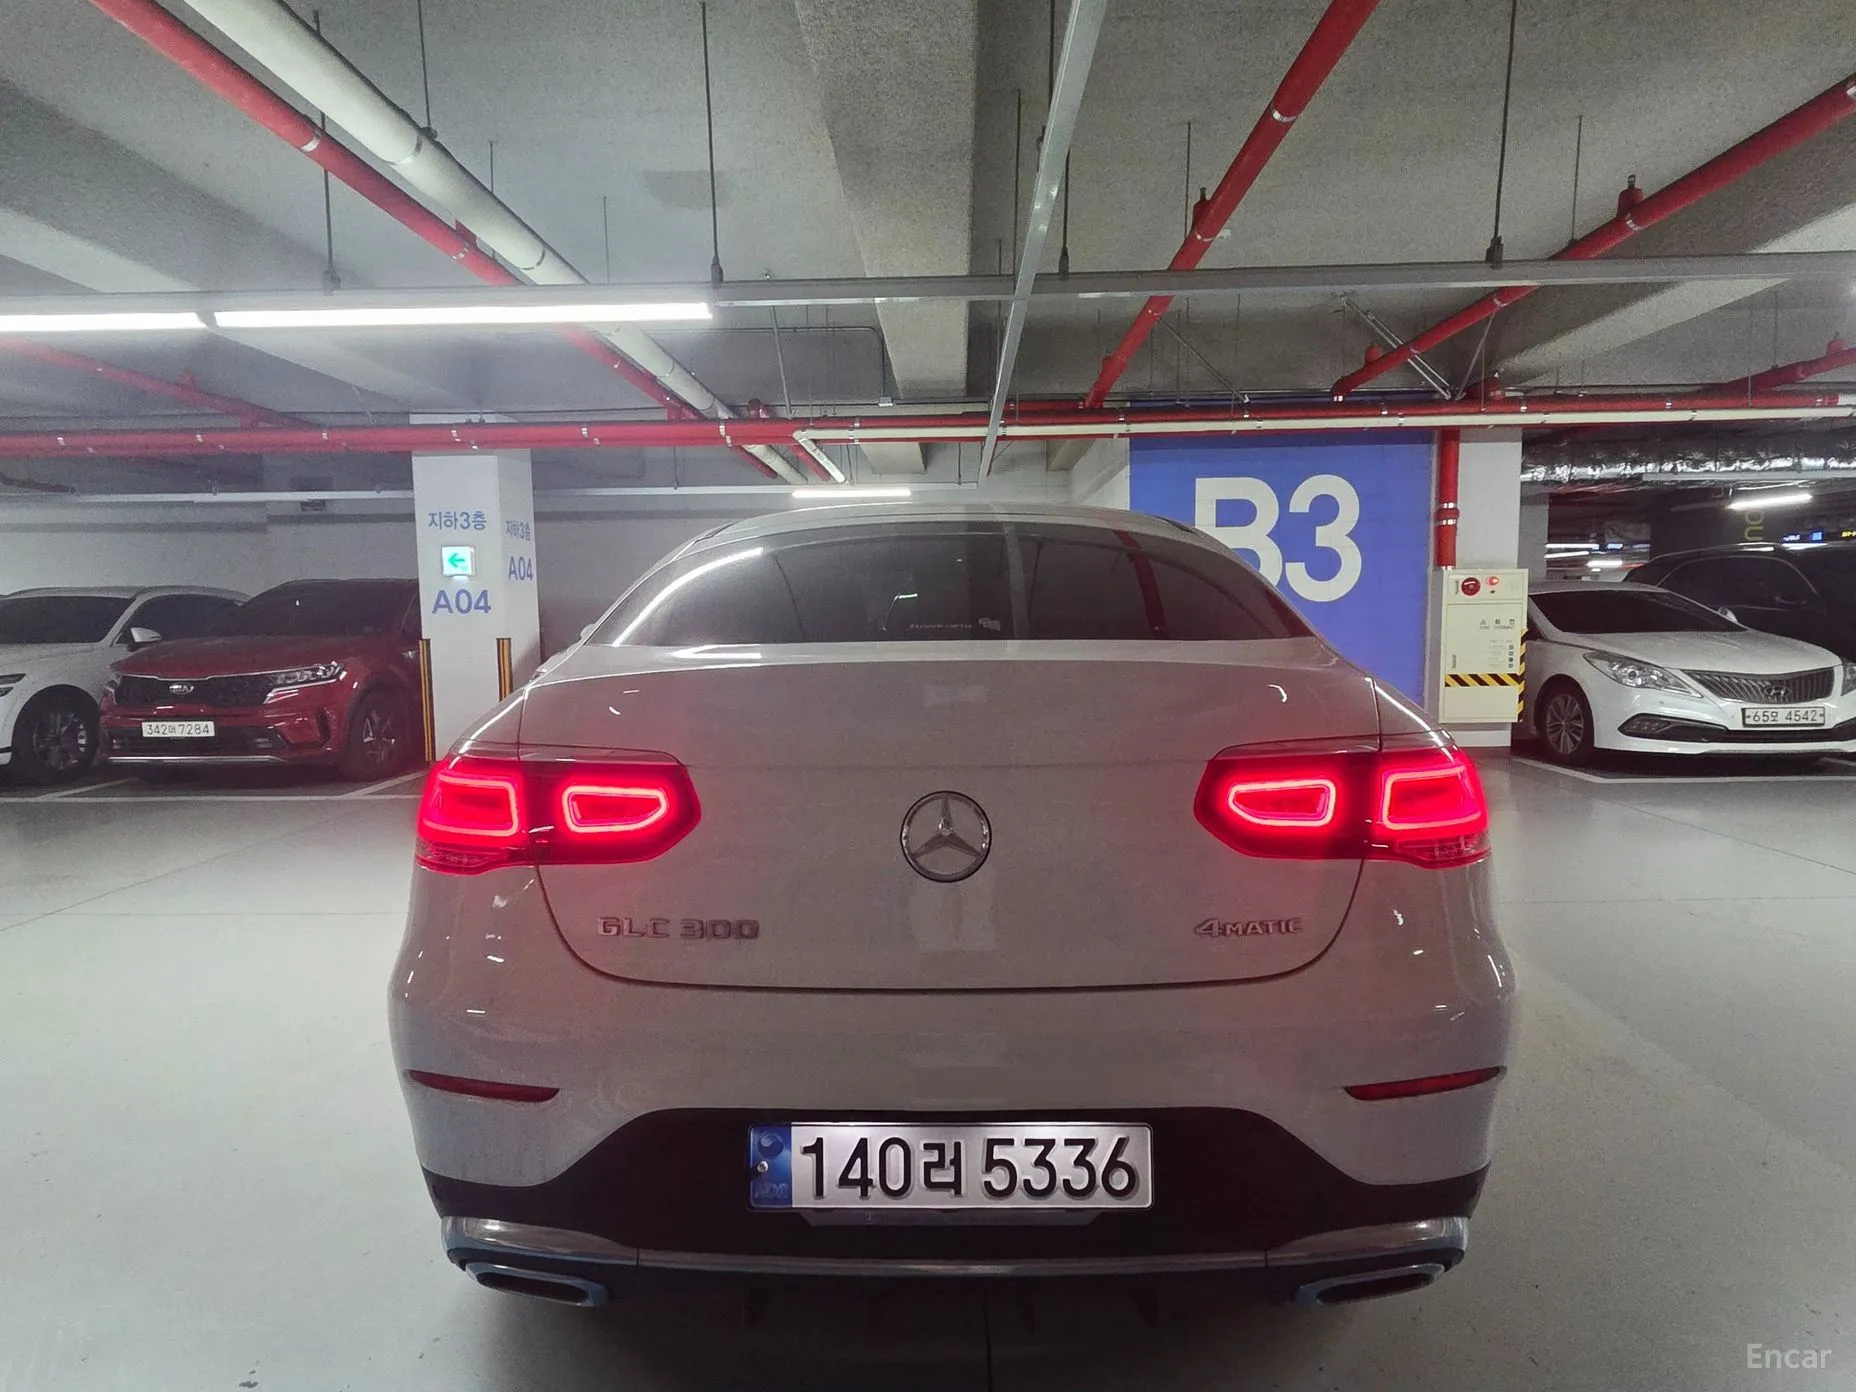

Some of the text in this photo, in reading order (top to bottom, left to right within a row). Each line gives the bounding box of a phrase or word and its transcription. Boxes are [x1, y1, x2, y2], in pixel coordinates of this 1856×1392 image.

[428, 511, 487, 531] 지하3층
[1195, 474, 1362, 602] B3
[508, 556, 534, 581] A04
[432, 589, 491, 614] A04
[1752, 709, 1817, 723] 65모 4542
[178, 724, 209, 736] 7284
[598, 916, 760, 940] GLC 300
[1194, 918, 1303, 937] 4MATIC
[802, 1136, 1137, 1198] 140러 5336
